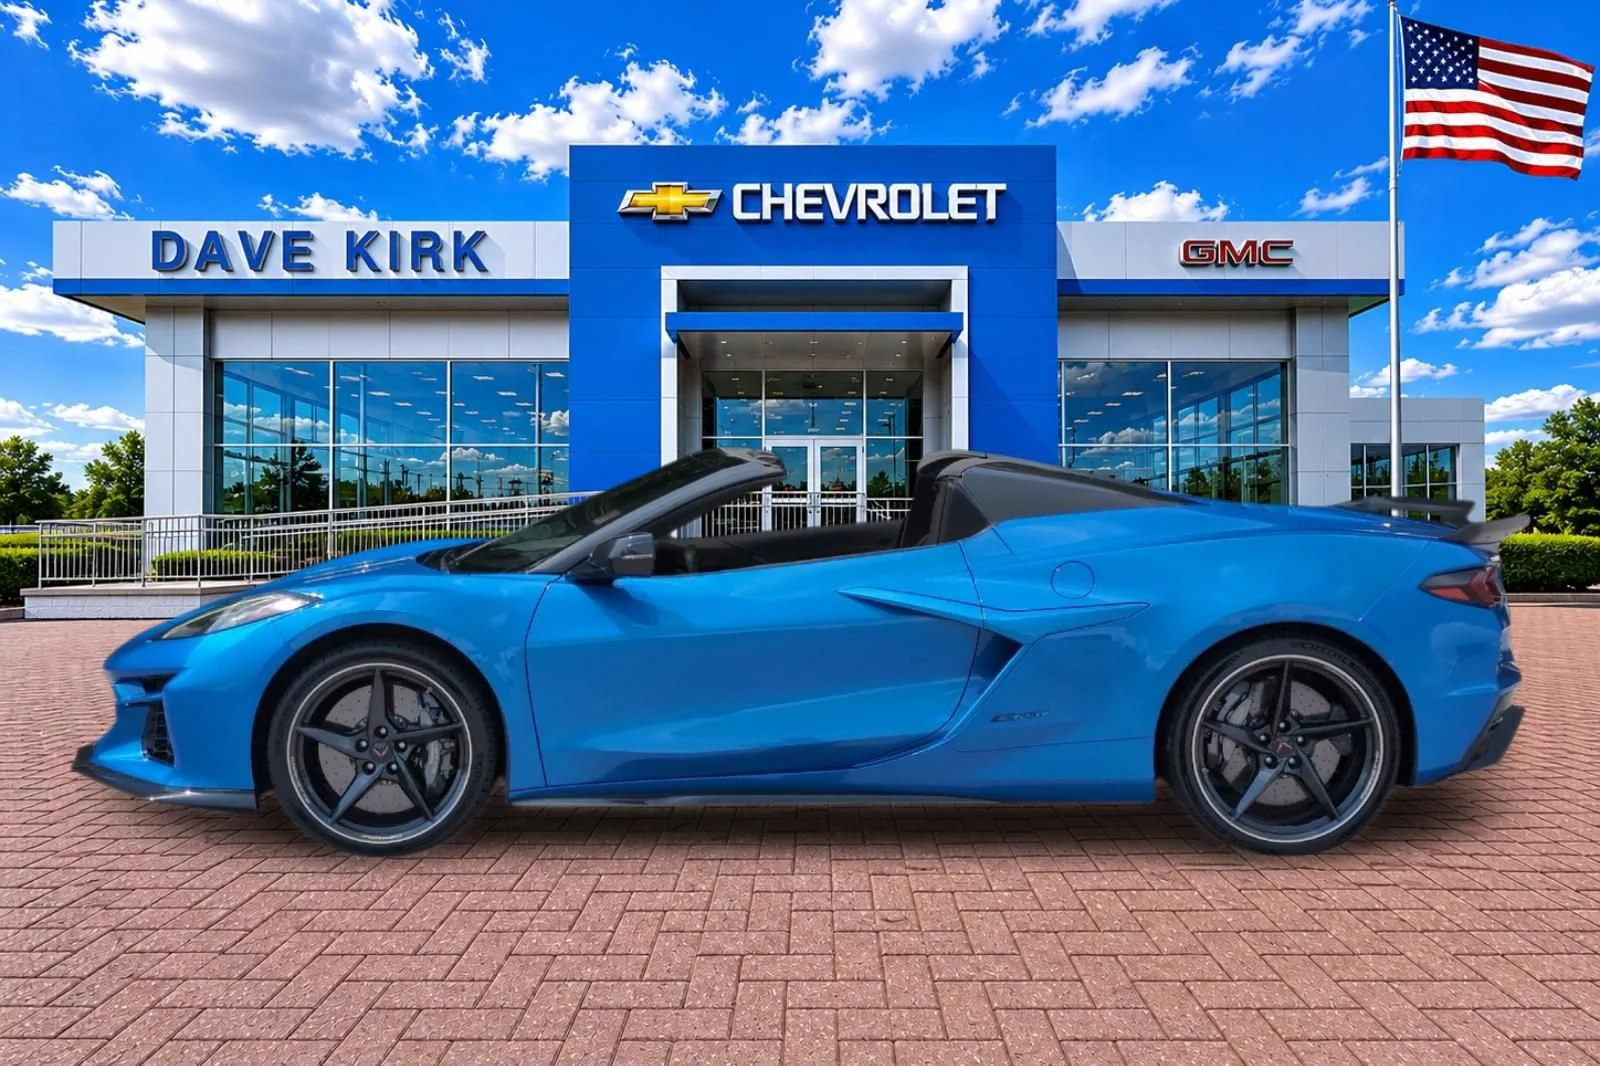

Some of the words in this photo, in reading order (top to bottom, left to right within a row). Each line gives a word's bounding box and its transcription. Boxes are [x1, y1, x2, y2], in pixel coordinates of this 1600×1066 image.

[732, 183, 1007, 221] CHEVROLET
[151, 230, 314, 272] DAVE
[345, 230, 488, 272] KIRK
[1180, 239, 1295, 266] GMC
